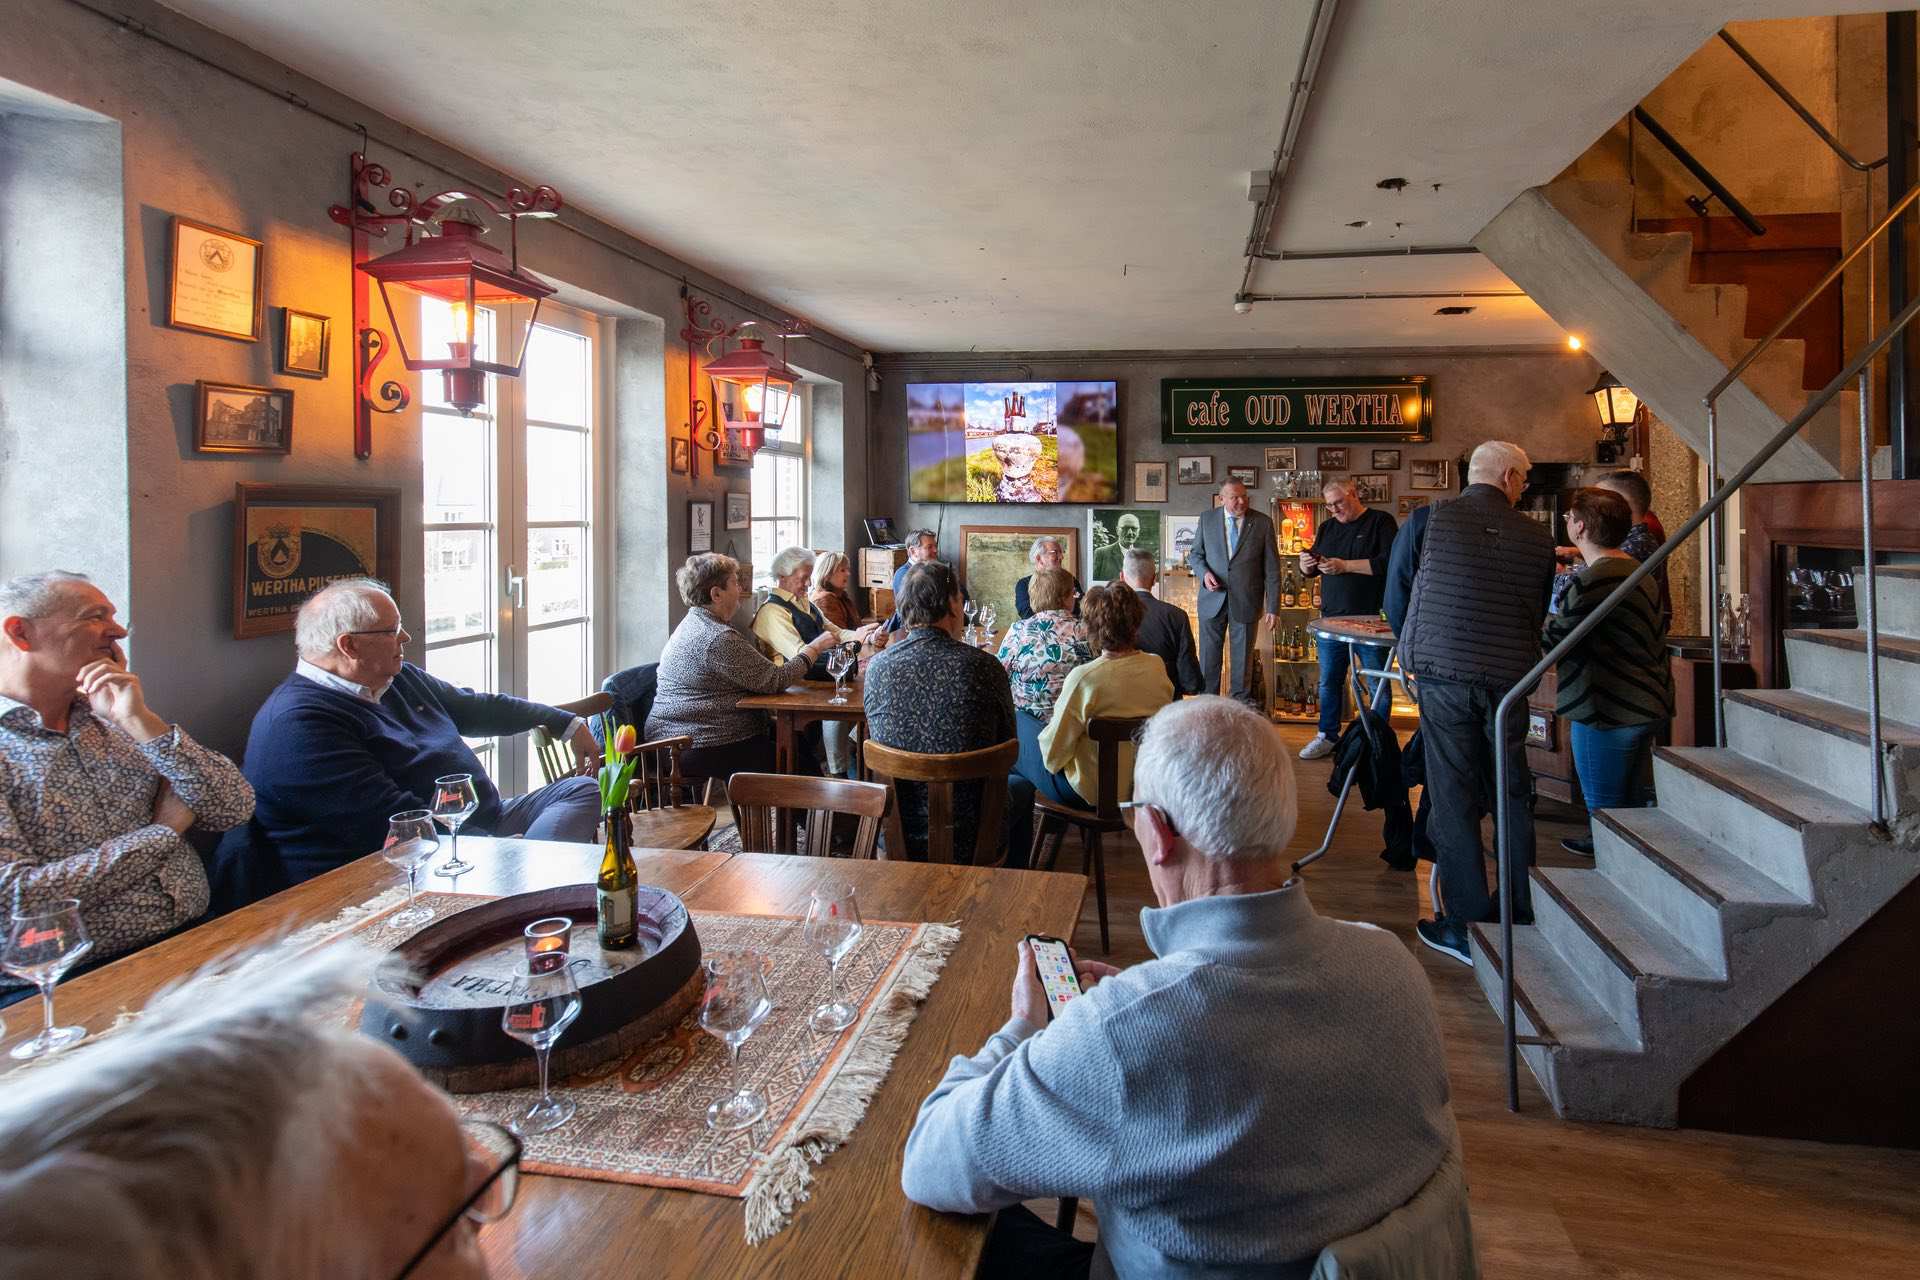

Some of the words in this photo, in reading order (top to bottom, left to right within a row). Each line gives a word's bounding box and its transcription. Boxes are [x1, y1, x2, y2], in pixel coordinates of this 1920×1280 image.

[1187, 390, 1230, 426] cafe
[1244, 394, 1291, 426] OUD
[1304, 394, 1404, 426] WERTHA
[251, 577, 305, 597] WERTHA
[308, 572, 367, 592] PILS
